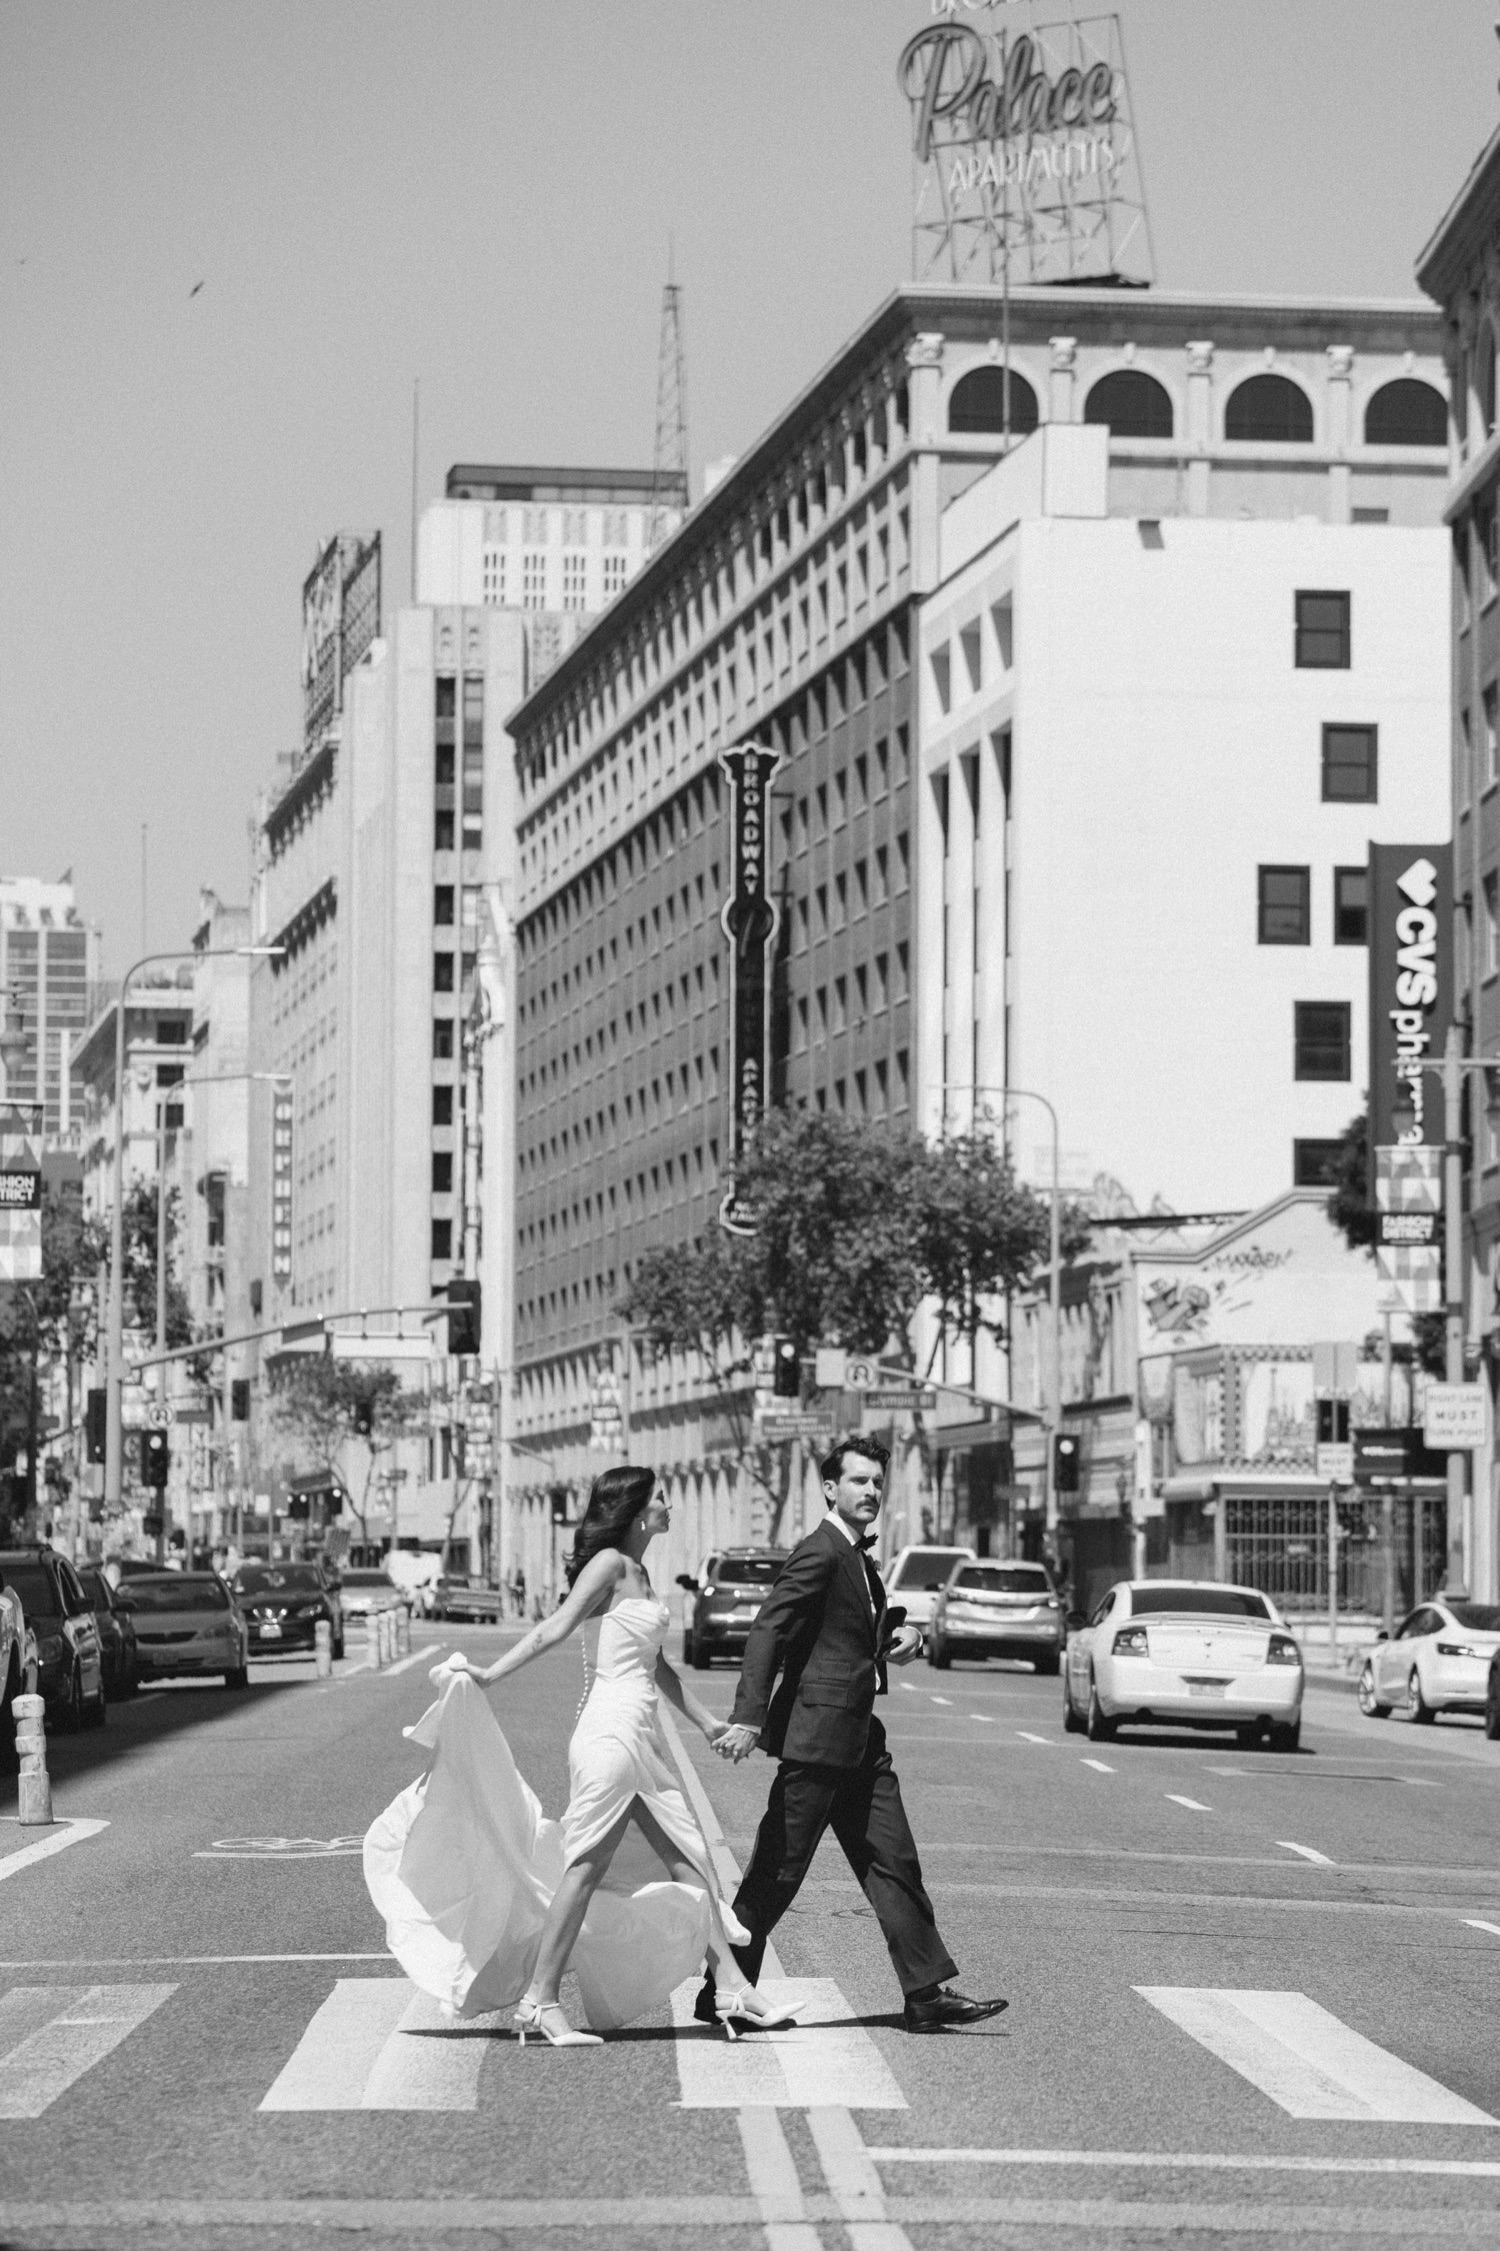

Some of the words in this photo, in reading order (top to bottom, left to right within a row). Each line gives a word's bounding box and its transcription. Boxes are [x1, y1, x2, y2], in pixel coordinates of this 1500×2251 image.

[897, 23, 1118, 163] Palace
[741, 754, 761, 895] BROADWAY
[1396, 907, 1438, 1005] CVS
[1389, 1010, 1431, 1146] phara
[0, 1175, 35, 1189] HION
[0, 1188, 33, 1201] TRICT
[1435, 1410, 1477, 1420] MUST
